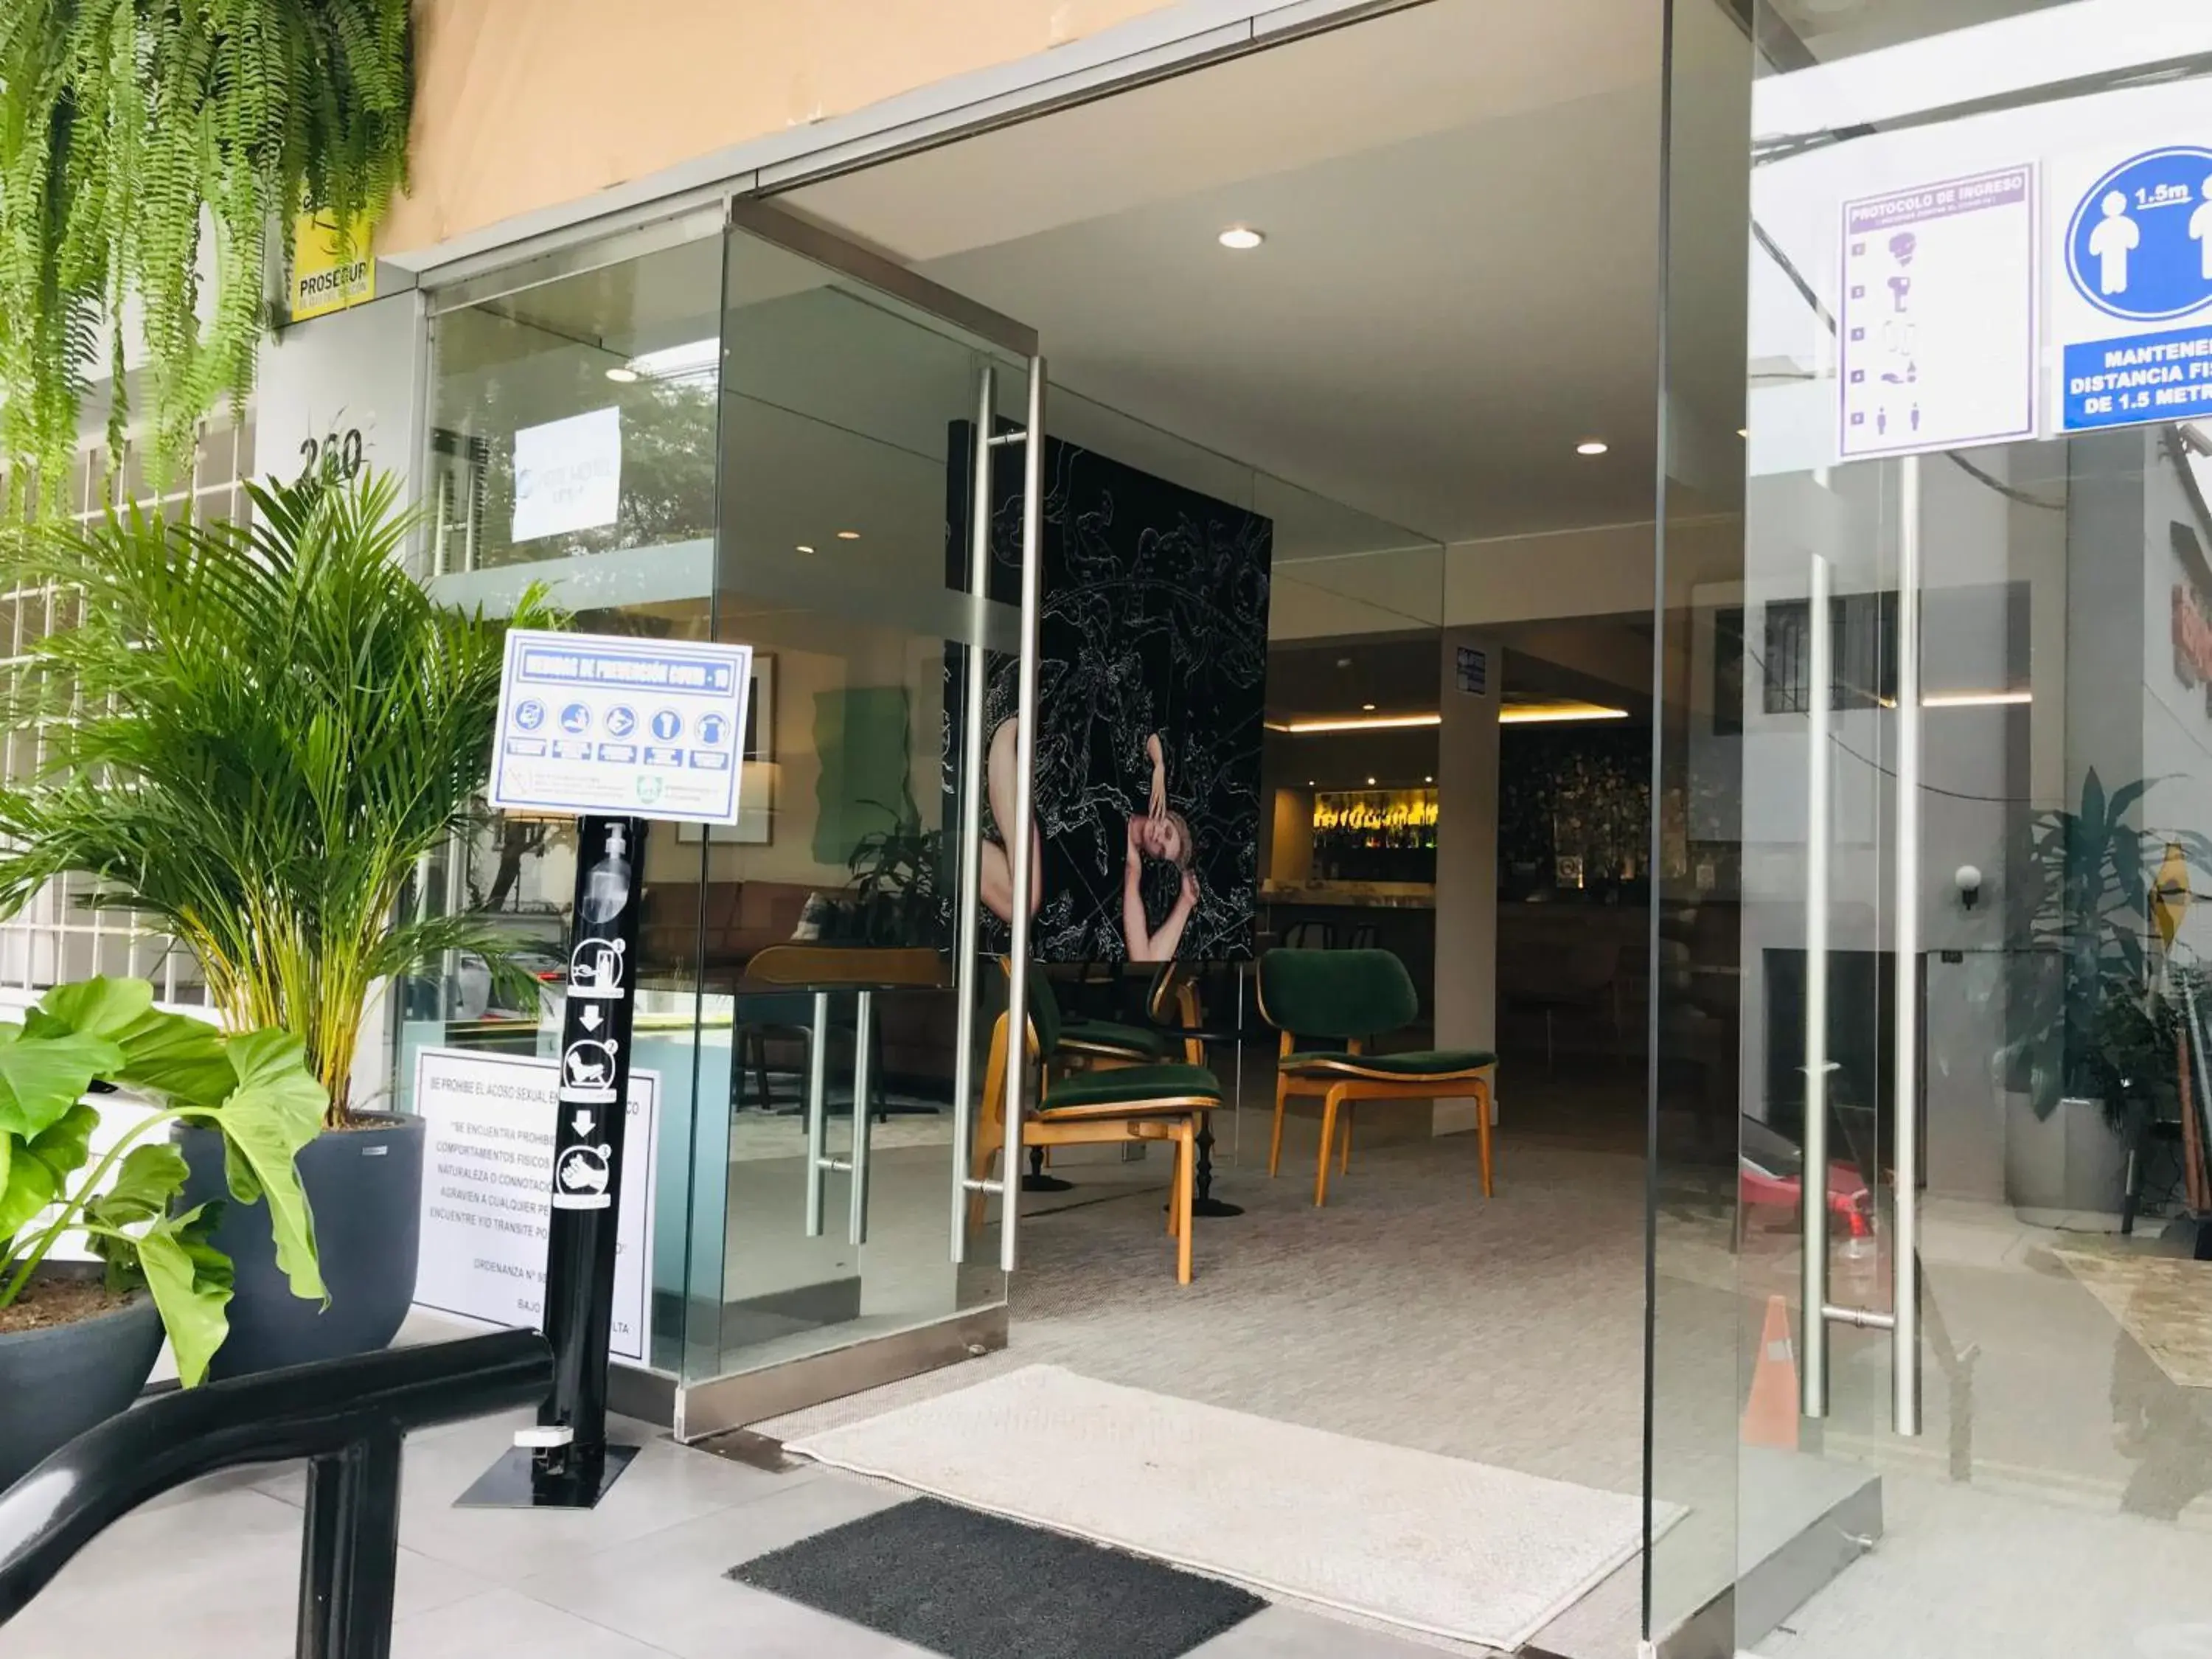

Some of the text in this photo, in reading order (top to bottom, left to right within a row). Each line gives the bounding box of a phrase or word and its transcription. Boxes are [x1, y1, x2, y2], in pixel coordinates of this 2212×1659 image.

[1851, 192, 1933, 221] PROTOCOLO
[1936, 189, 1956, 205] DE
[1959, 175, 2023, 200] INGRESO
[2135, 184, 2188, 204] 1.5m
[2104, 338, 2212, 369] MANTENE
[2070, 364, 2183, 395] DISTANCIA
[2084, 395, 2113, 415] DE
[2118, 391, 2149, 410] 1.5
[442, 1077, 475, 1095] PROHIBE
[476, 1081, 485, 1096] EL
[487, 1082, 515, 1099] ACOSO
[515, 1086, 547, 1104] SEXUAL
[467, 1122, 515, 1141] ENCUENTRA
[437, 1164, 489, 1183] NATURALEZA
[487, 1194, 536, 1214] CUALQUIER
[430, 1206, 477, 1225] ENCUENTRE
[493, 1217, 533, 1238] TRANSITE
[473, 1257, 524, 1279] ORDENANZA
[517, 1298, 541, 1314] BAJO
